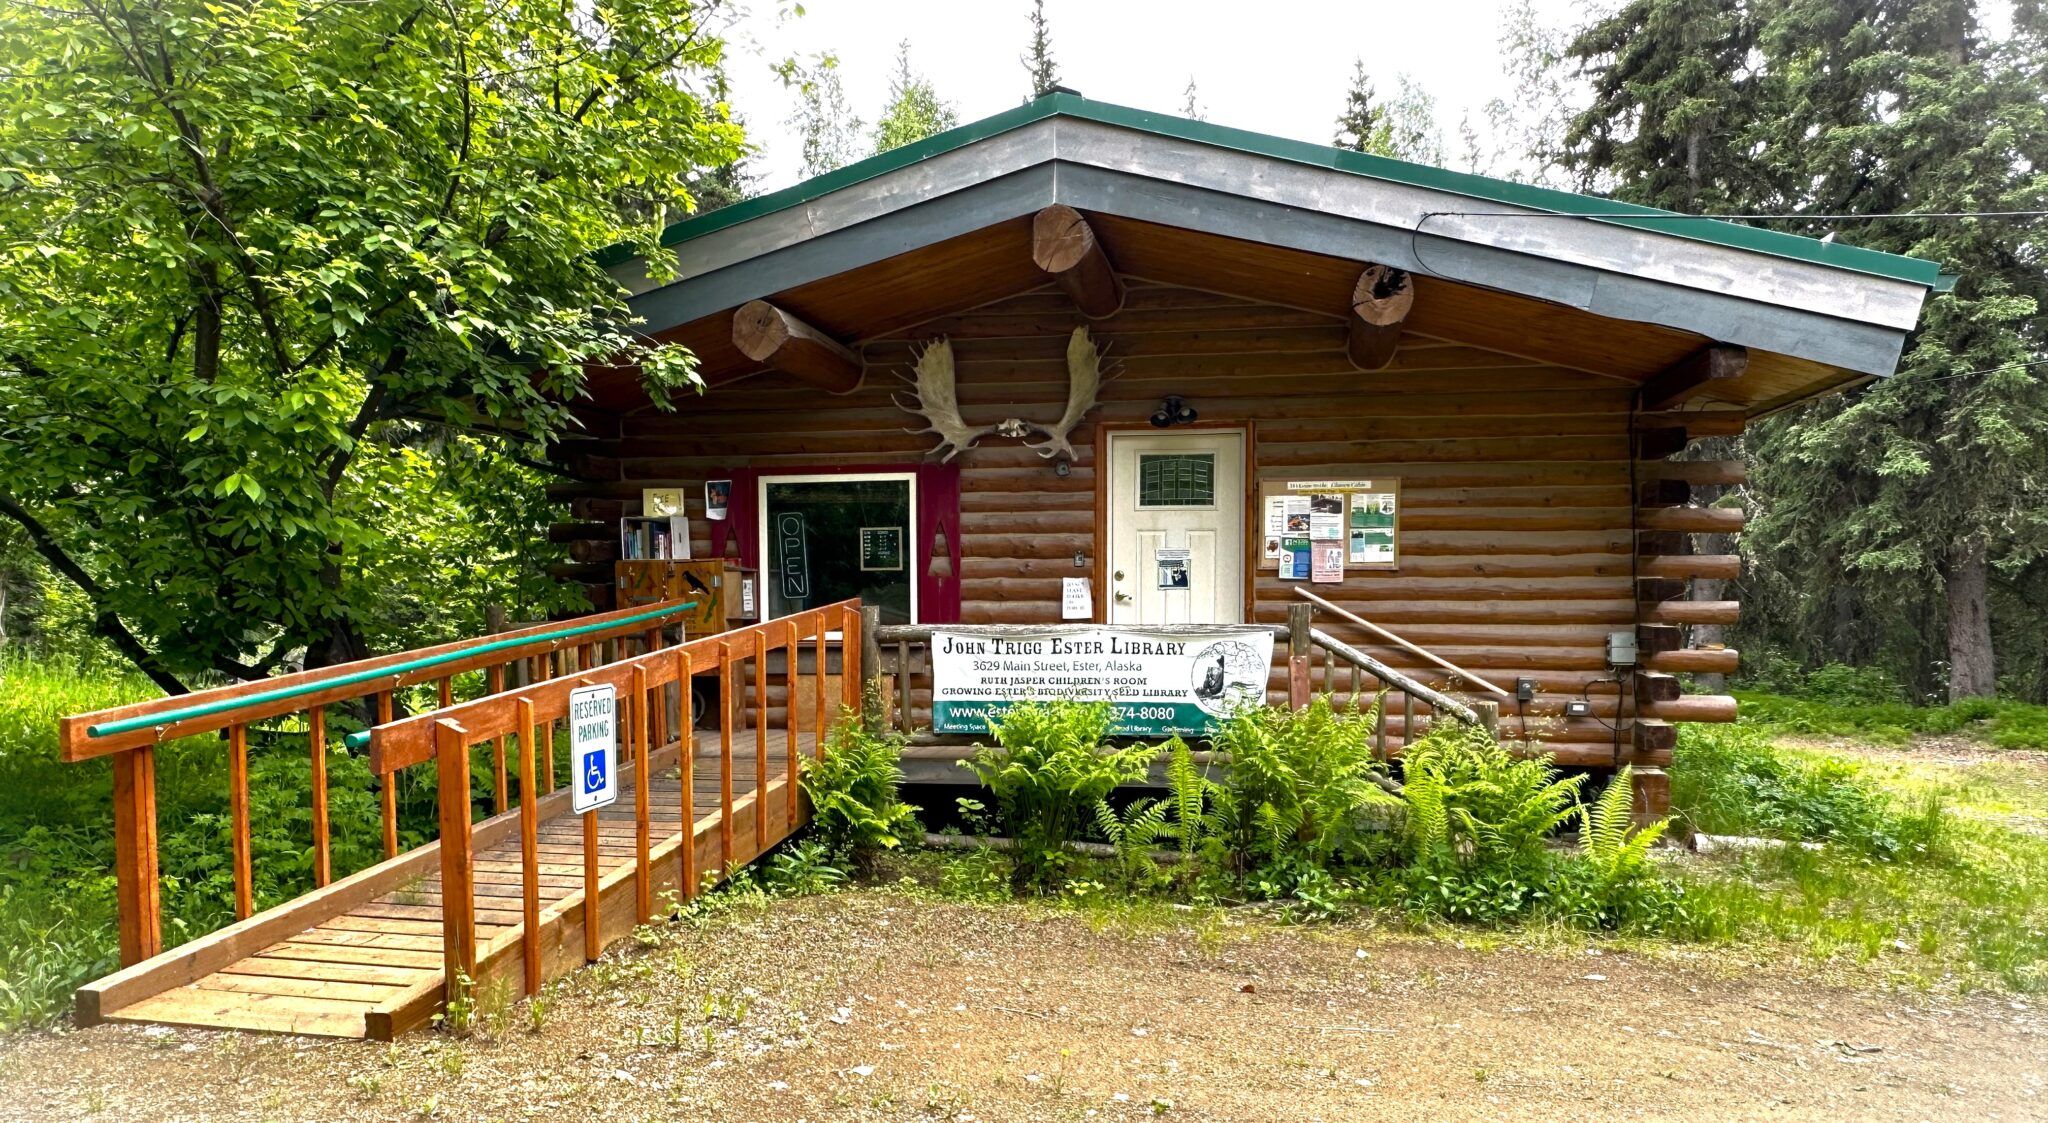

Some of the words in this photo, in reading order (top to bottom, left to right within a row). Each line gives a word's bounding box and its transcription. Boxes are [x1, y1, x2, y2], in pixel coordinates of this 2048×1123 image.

[782, 516, 805, 594] OPEN
[943, 637, 985, 654] JOHN
[992, 638, 1042, 655] TRIGG
[1051, 637, 1104, 655] ESTER
[1111, 637, 1186, 655] LIBRARY
[973, 660, 1000, 671] 3629
[1003, 661, 1031, 671] Main
[1034, 661, 1069, 672] Street,
[1073, 661, 1102, 672] Ester,
[1105, 660, 1142, 671] Alaska
[1010, 677, 1045, 685] JASPER
[1048, 677, 1110, 685] CHILDREN'S
[1113, 677, 1148, 685] ROOM
[942, 687, 992, 695] GROWING
[995, 687, 1035, 695] ESTER'S
[1112, 688, 1140, 696] SEED
[1142, 689, 1189, 697] LIBRARY
[574, 697, 611, 720] RESERVED
[578, 720, 609, 743] PARKING
[943, 723, 968, 731] Meeting
[1161, 725, 1194, 734] Gaening
